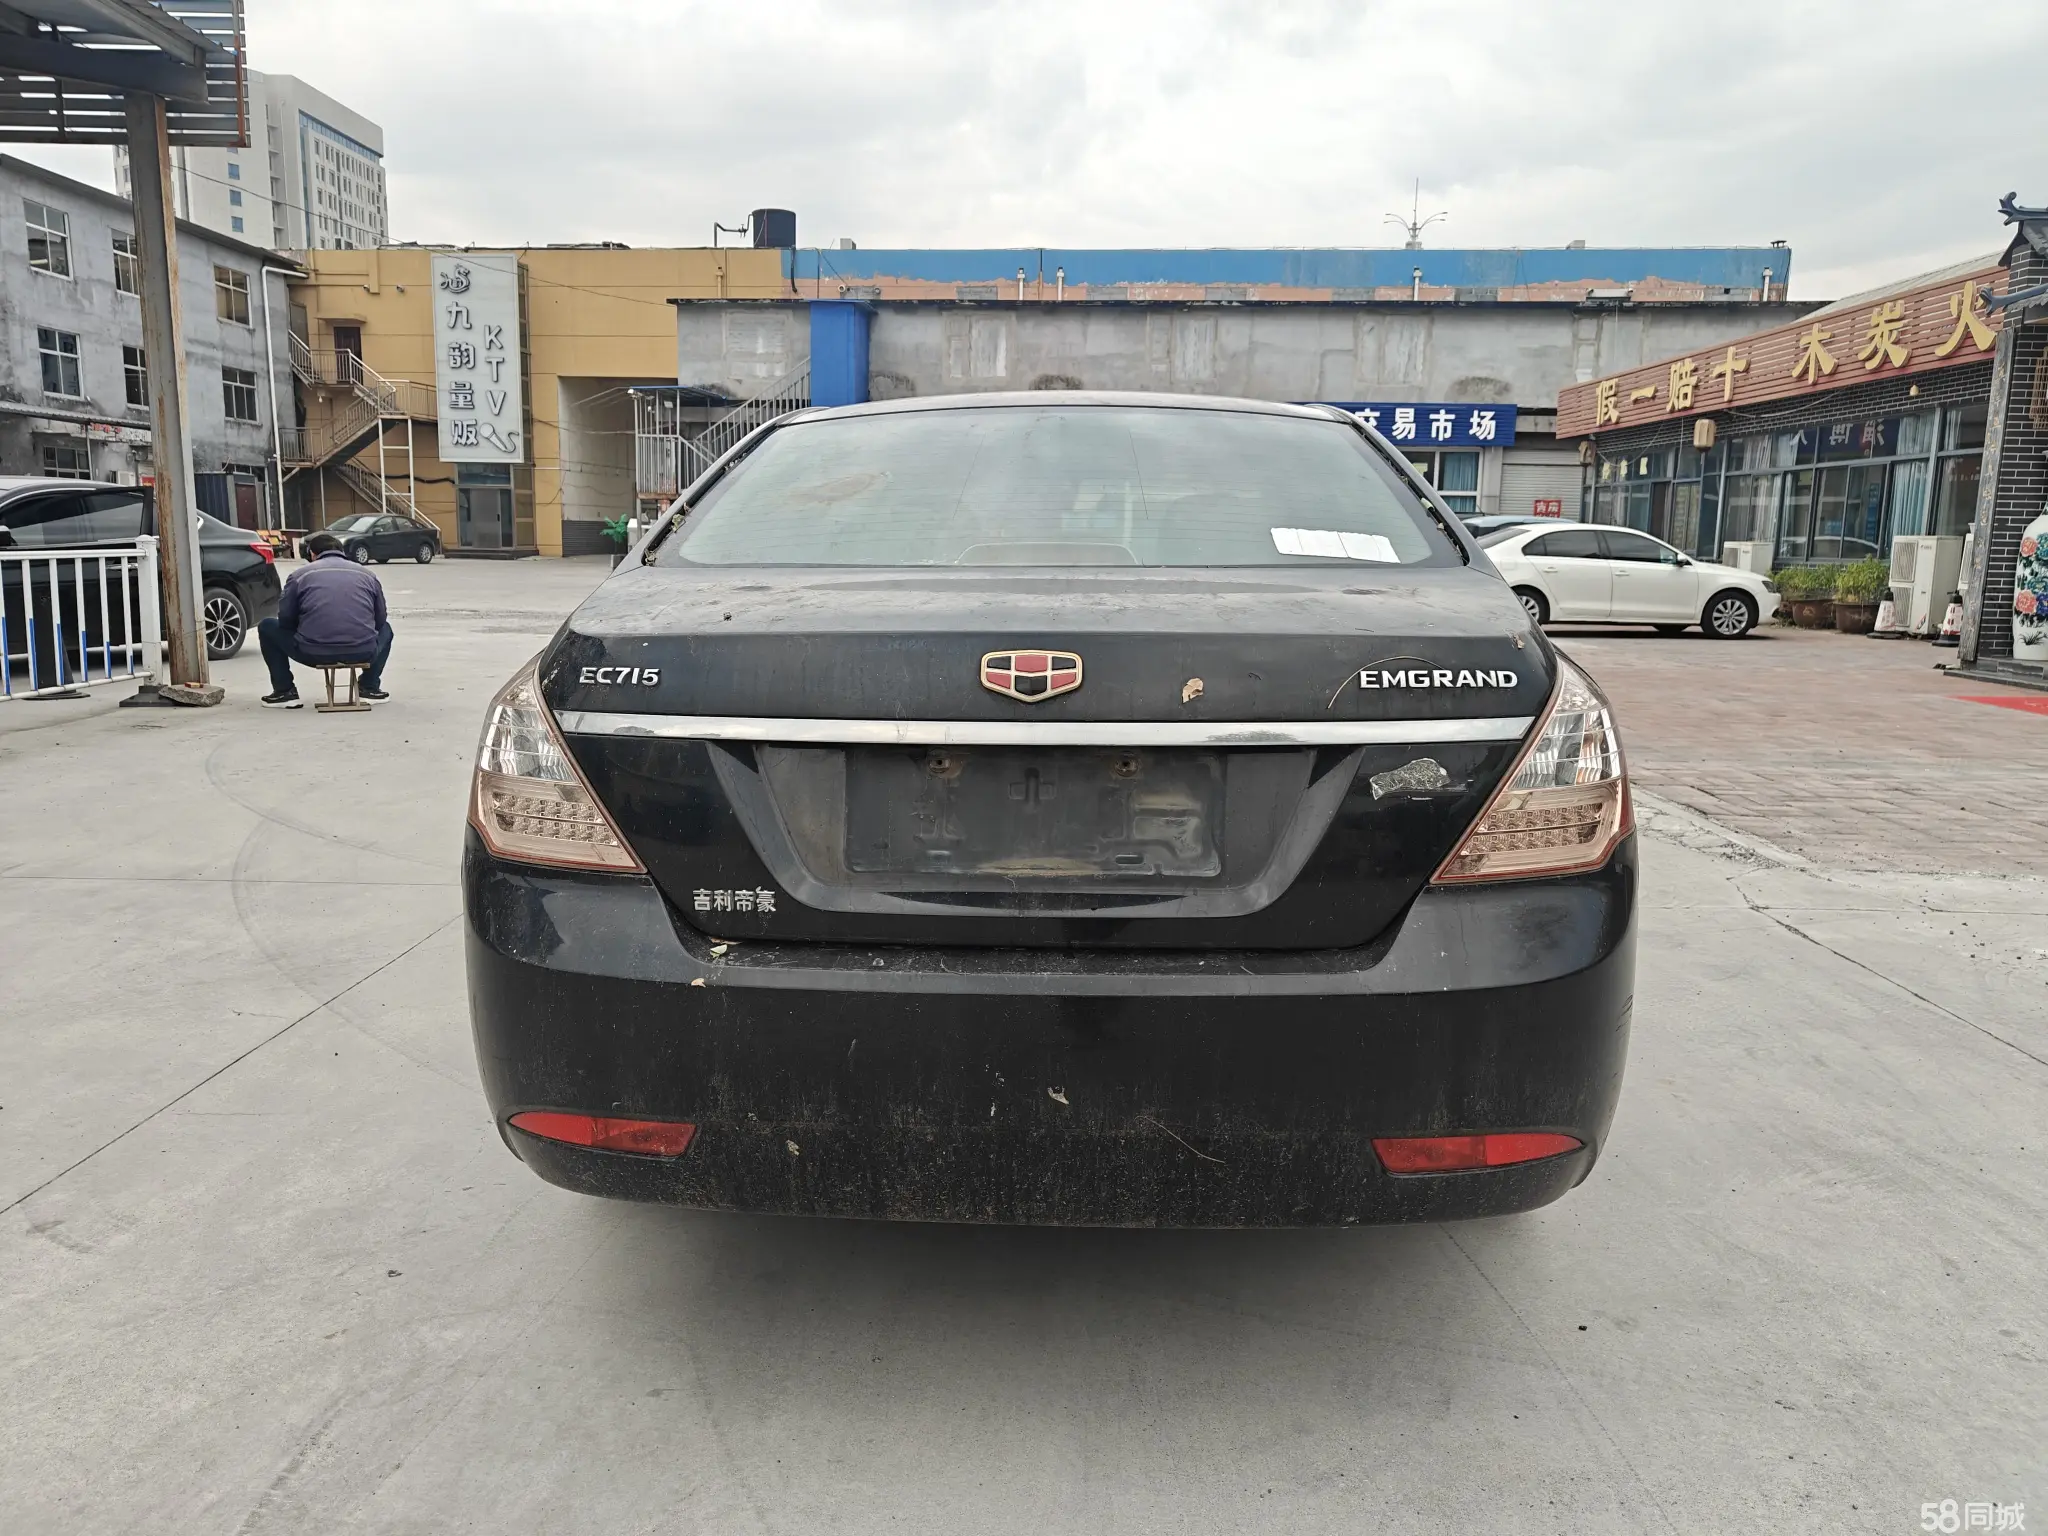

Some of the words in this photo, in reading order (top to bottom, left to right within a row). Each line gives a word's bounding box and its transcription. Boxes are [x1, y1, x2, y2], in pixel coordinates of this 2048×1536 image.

[446, 301, 479, 447] 九韵量贩
[483, 324, 506, 416] KTV
[1595, 345, 1752, 426] 假一赔十
[1791, 280, 1998, 386] 木炭火
[579, 667, 660, 687] EC715
[1359, 669, 1519, 689] EMGRAND
[692, 886, 777, 912] 吉利帝豪
